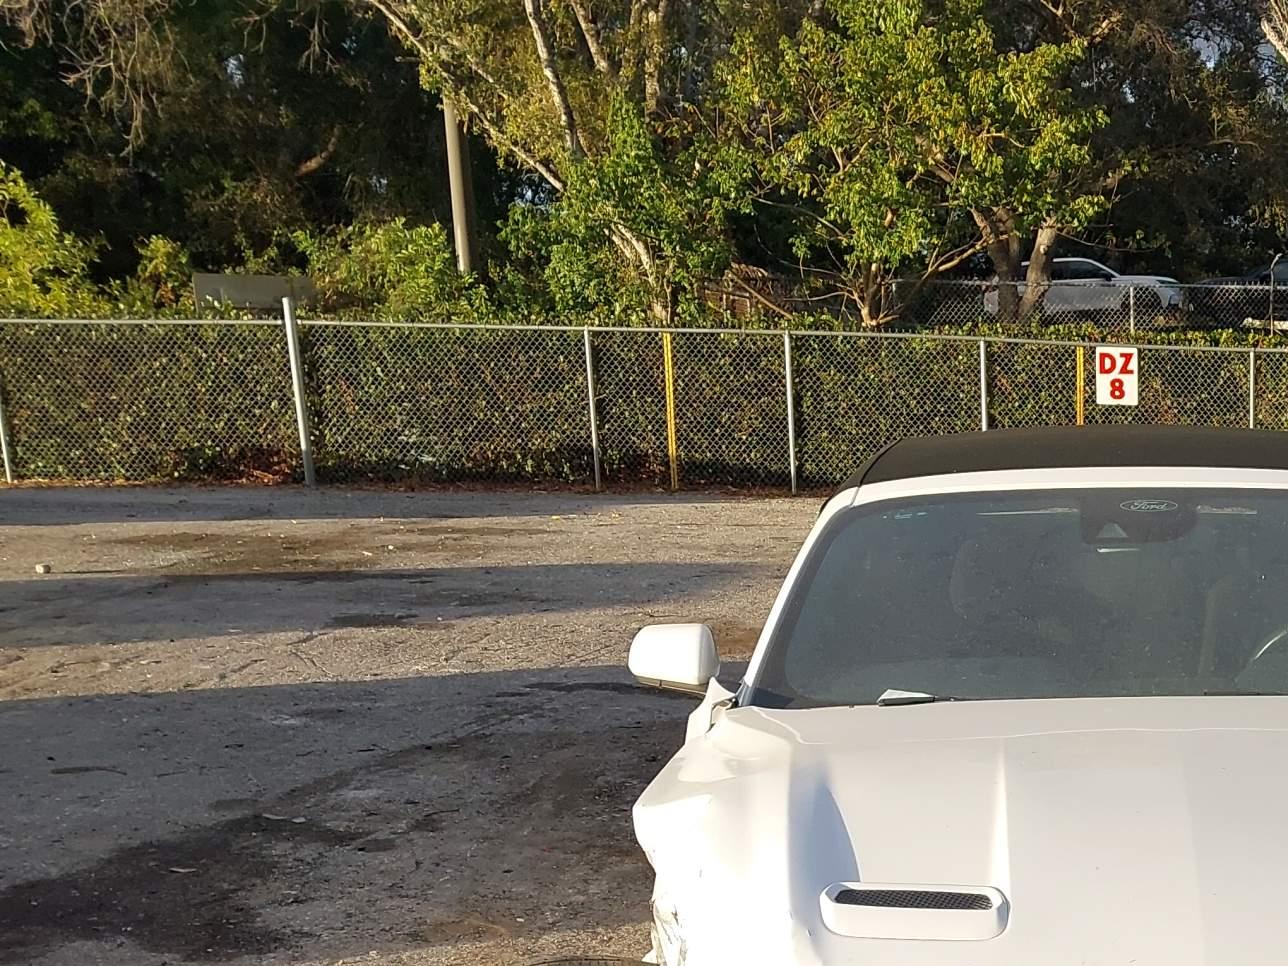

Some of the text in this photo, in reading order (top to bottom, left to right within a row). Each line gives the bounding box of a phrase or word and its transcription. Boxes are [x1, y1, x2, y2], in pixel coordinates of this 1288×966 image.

[1098, 352, 1135, 375] DZ
[1109, 378, 1126, 400] 8
[1127, 499, 1169, 511] Ford
